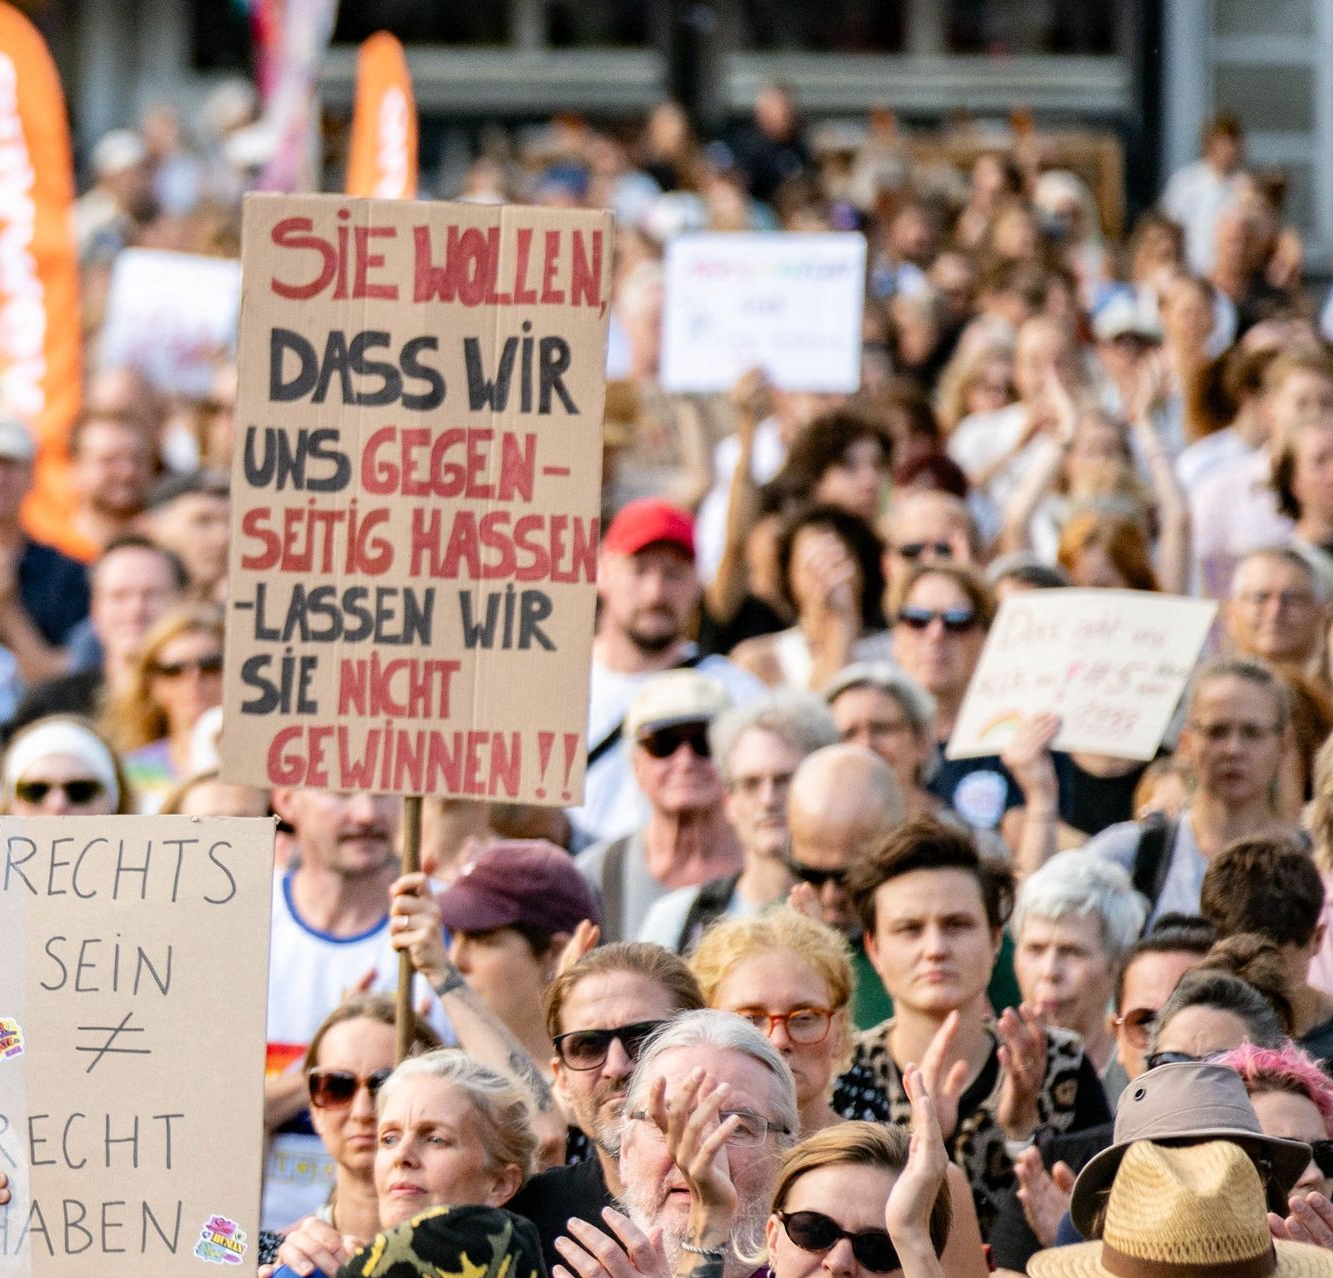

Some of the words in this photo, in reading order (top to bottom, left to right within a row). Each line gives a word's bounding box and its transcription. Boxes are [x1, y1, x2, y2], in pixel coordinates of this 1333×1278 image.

[269, 326, 446, 412] DASS
[243, 425, 352, 493] UNS
[408, 507, 601, 584] HASSEN
[337, 650, 462, 721] NICHT
[3, 836, 237, 905] RECHTS
